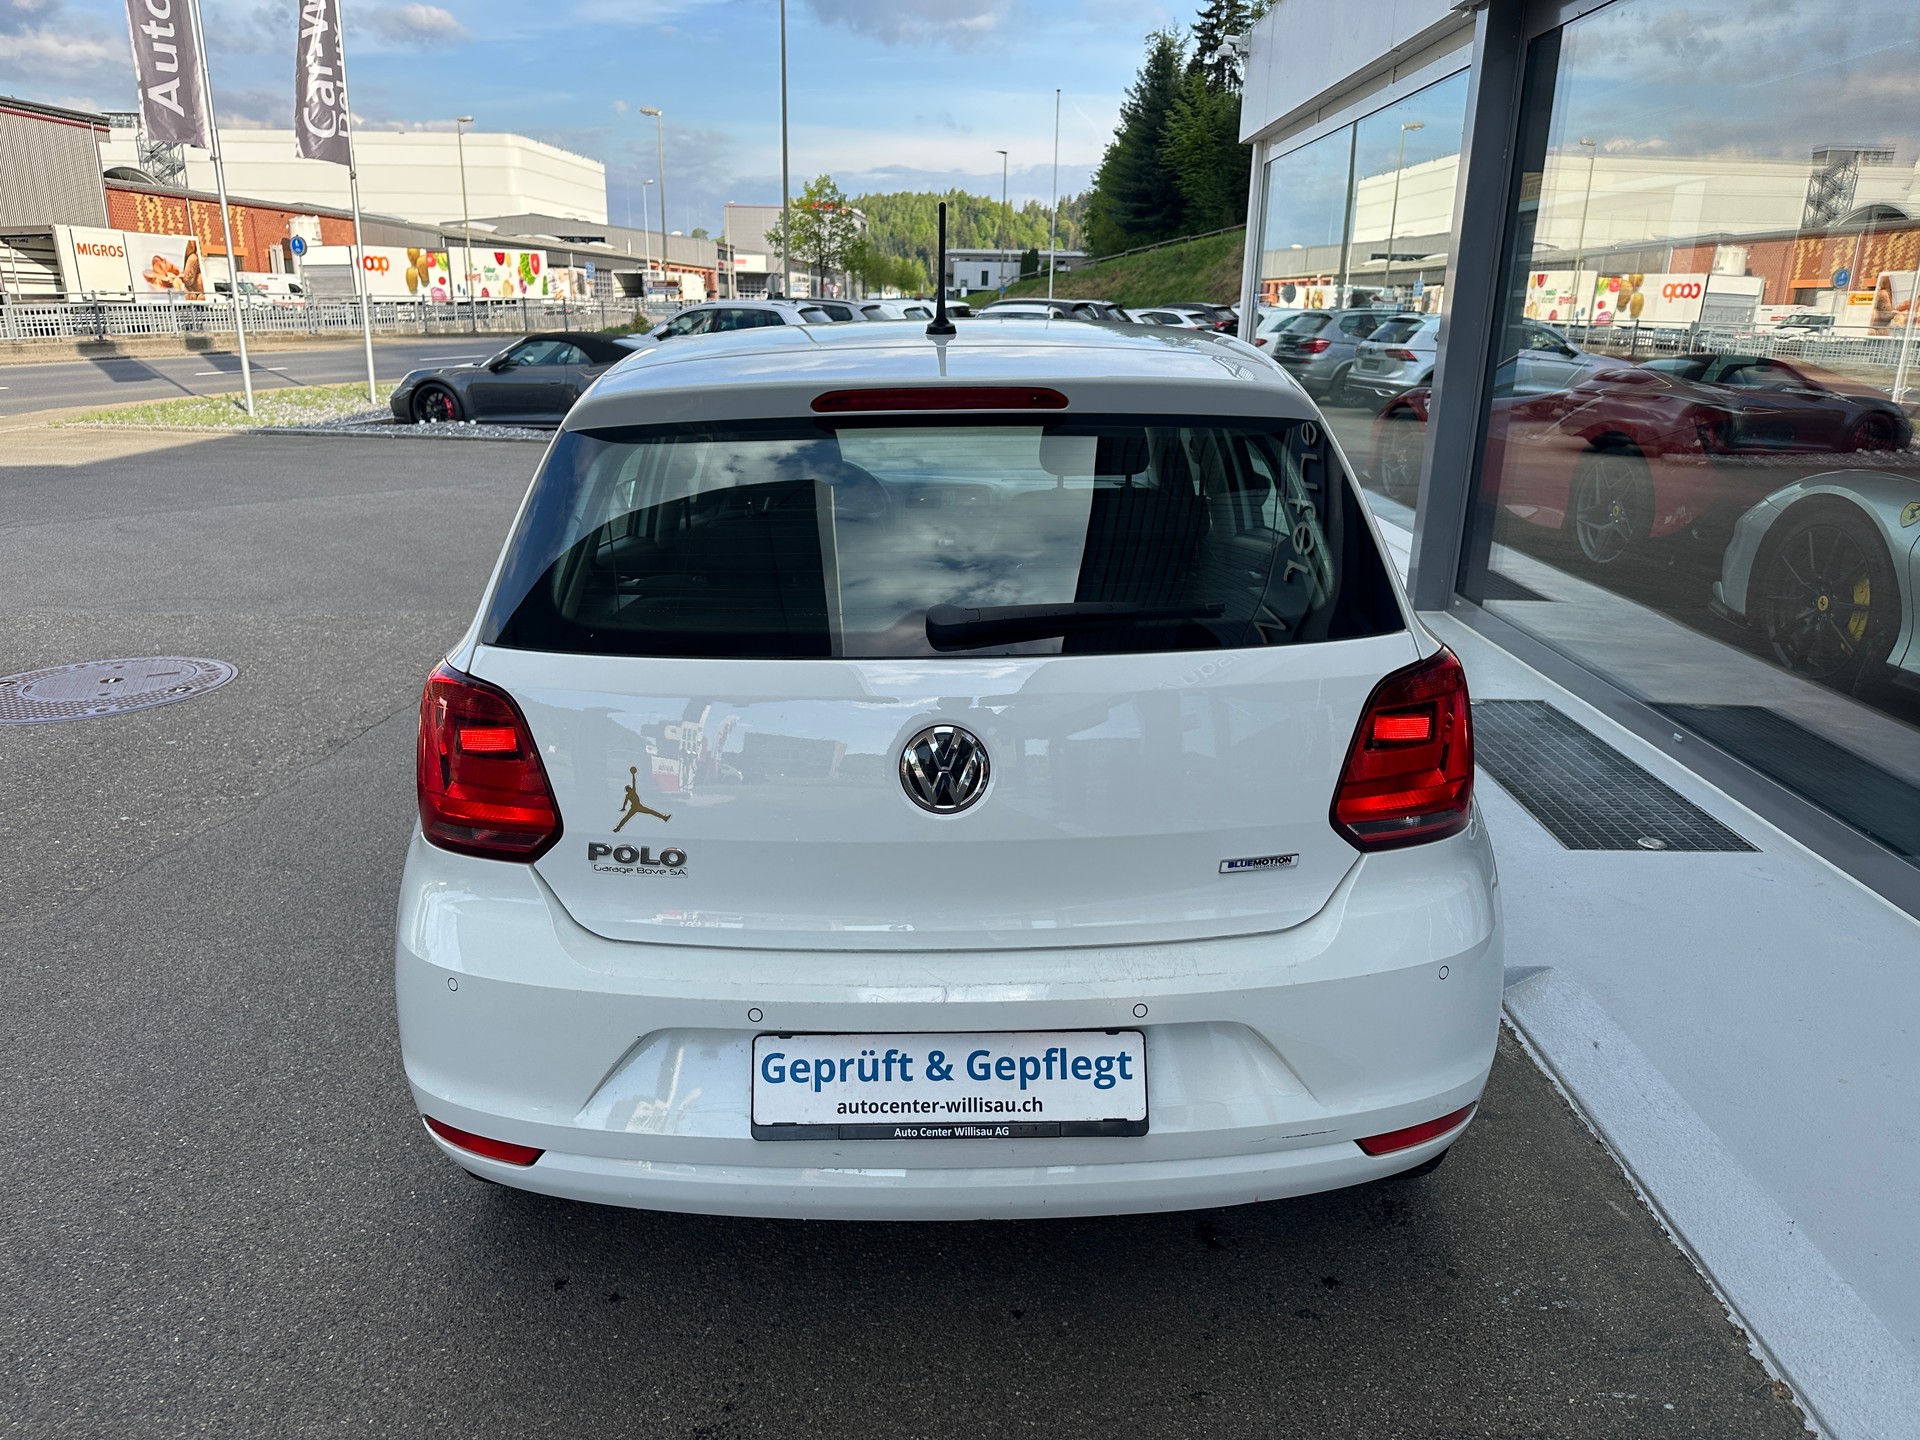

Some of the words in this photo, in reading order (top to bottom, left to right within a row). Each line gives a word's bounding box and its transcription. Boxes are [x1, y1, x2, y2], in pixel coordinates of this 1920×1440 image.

[140, 0, 185, 118] Auto
[76, 242, 124, 258] MIGROS
[356, 255, 390, 277] oop
[587, 842, 687, 867] POLO
[1227, 856, 1292, 868] BLUEMOTION
[593, 864, 634, 874] Garage
[636, 867, 667, 875] Bove
[669, 868, 687, 876] SA
[760, 1049, 914, 1093] Geprüft
[925, 1049, 954, 1082] &
[966, 1047, 1133, 1090] Gepflegt
[836, 1096, 1043, 1116] autocenter-willisau.ch
[894, 1126, 918, 1138] Auto
[919, 1126, 952, 1138] Center
[953, 1126, 994, 1138] Willisau
[995, 1125, 1010, 1137] AG
